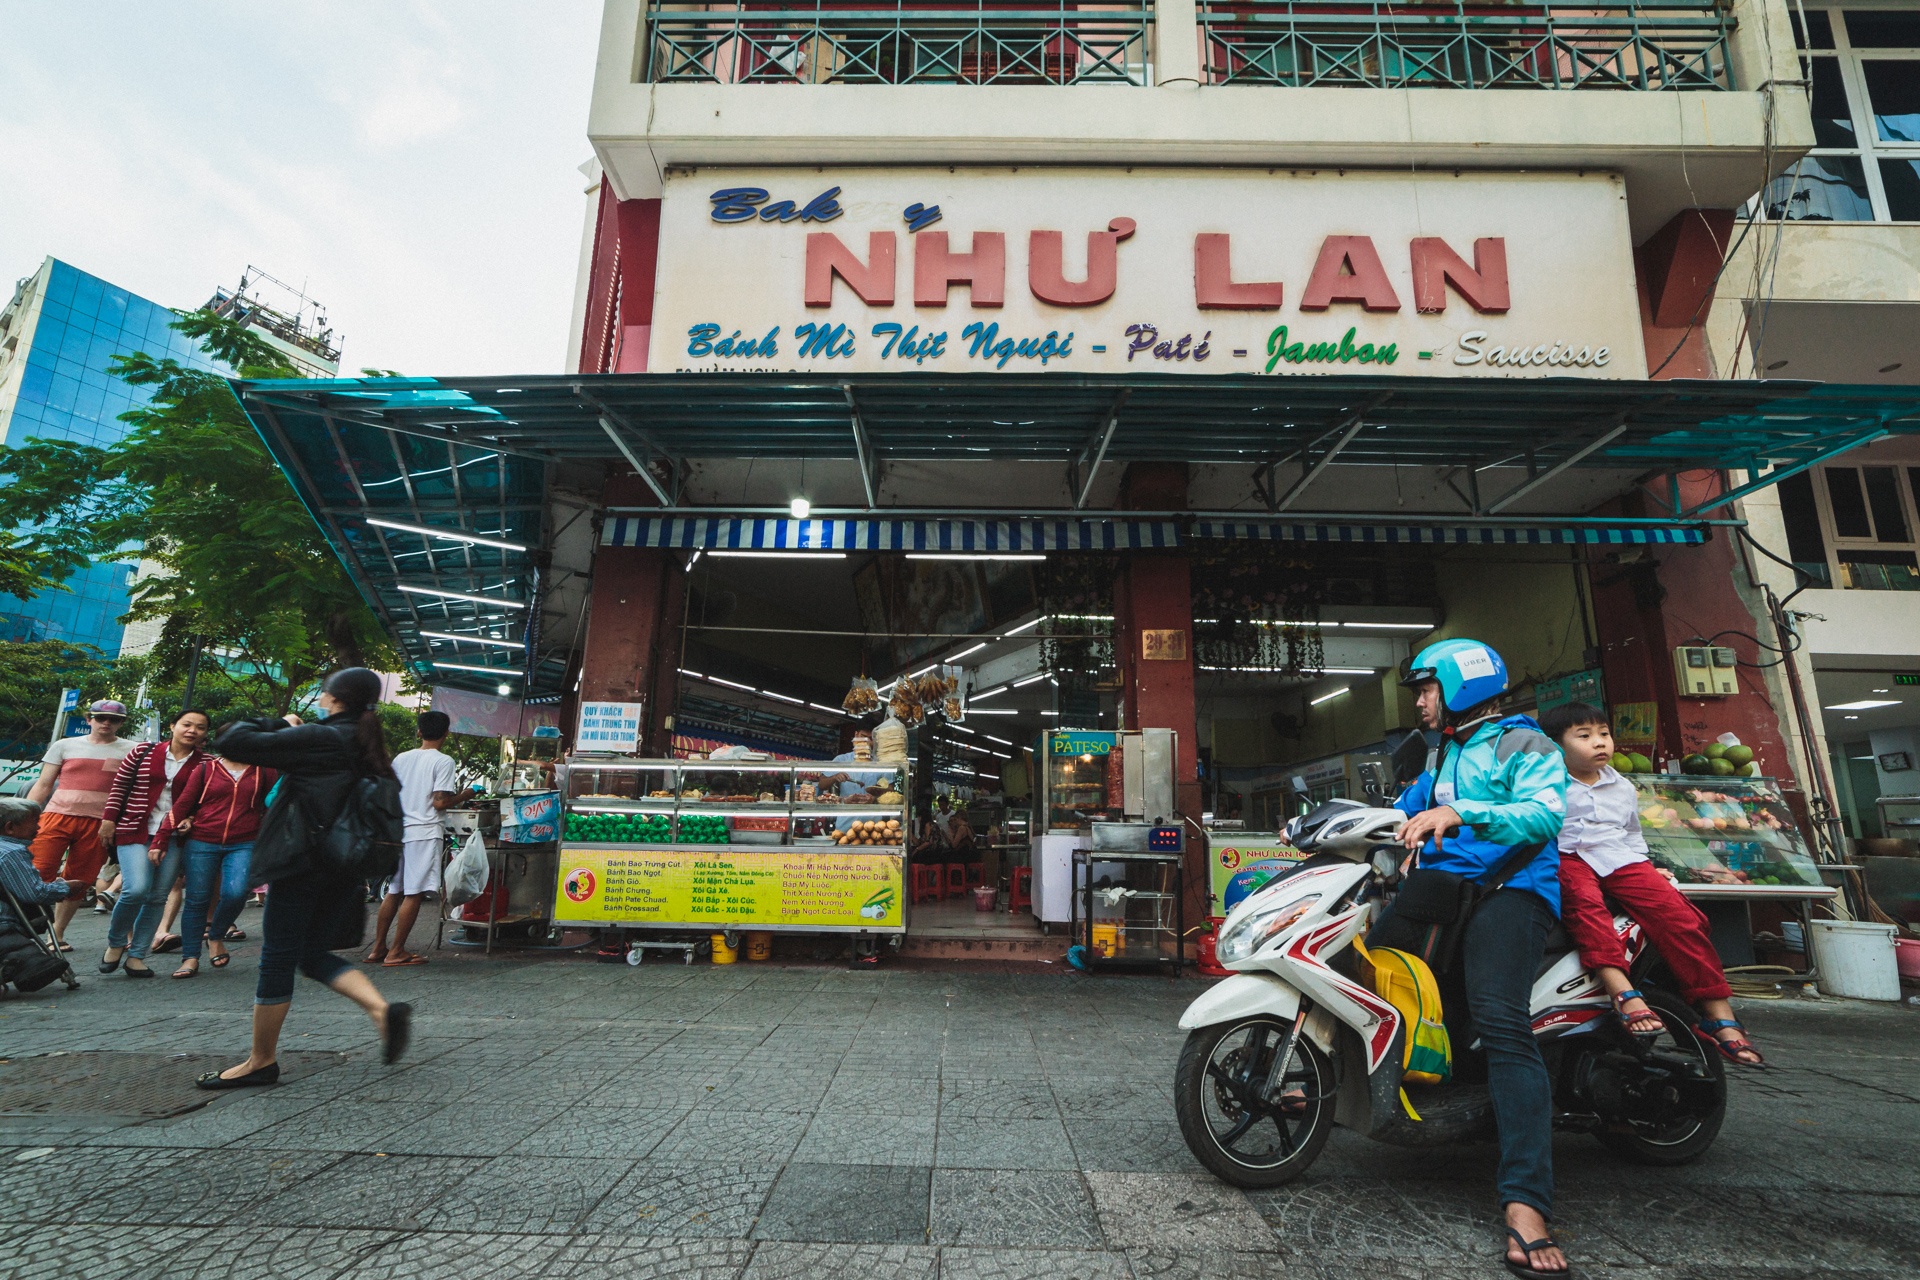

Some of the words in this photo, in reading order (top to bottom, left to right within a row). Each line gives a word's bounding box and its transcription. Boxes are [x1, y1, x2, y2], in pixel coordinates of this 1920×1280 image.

[804, 217, 1136, 308] NHƯ
[1195, 233, 1510, 314] LAN
[688, 322, 780, 359] Bánh
[794, 322, 855, 359] Mì
[872, 322, 945, 365] Thịt
[962, 321, 1075, 369] Nguội
[1124, 322, 1212, 362] Paté
[1265, 325, 1399, 373] Jambon
[1453, 331, 1612, 368] Saucisse
[1464, 658, 1487, 666] UBER
[600, 706, 622, 716] KHÁCH
[602, 719, 622, 728] TRUNG
[624, 720, 636, 729] THU
[1055, 741, 1110, 753] PATESO
